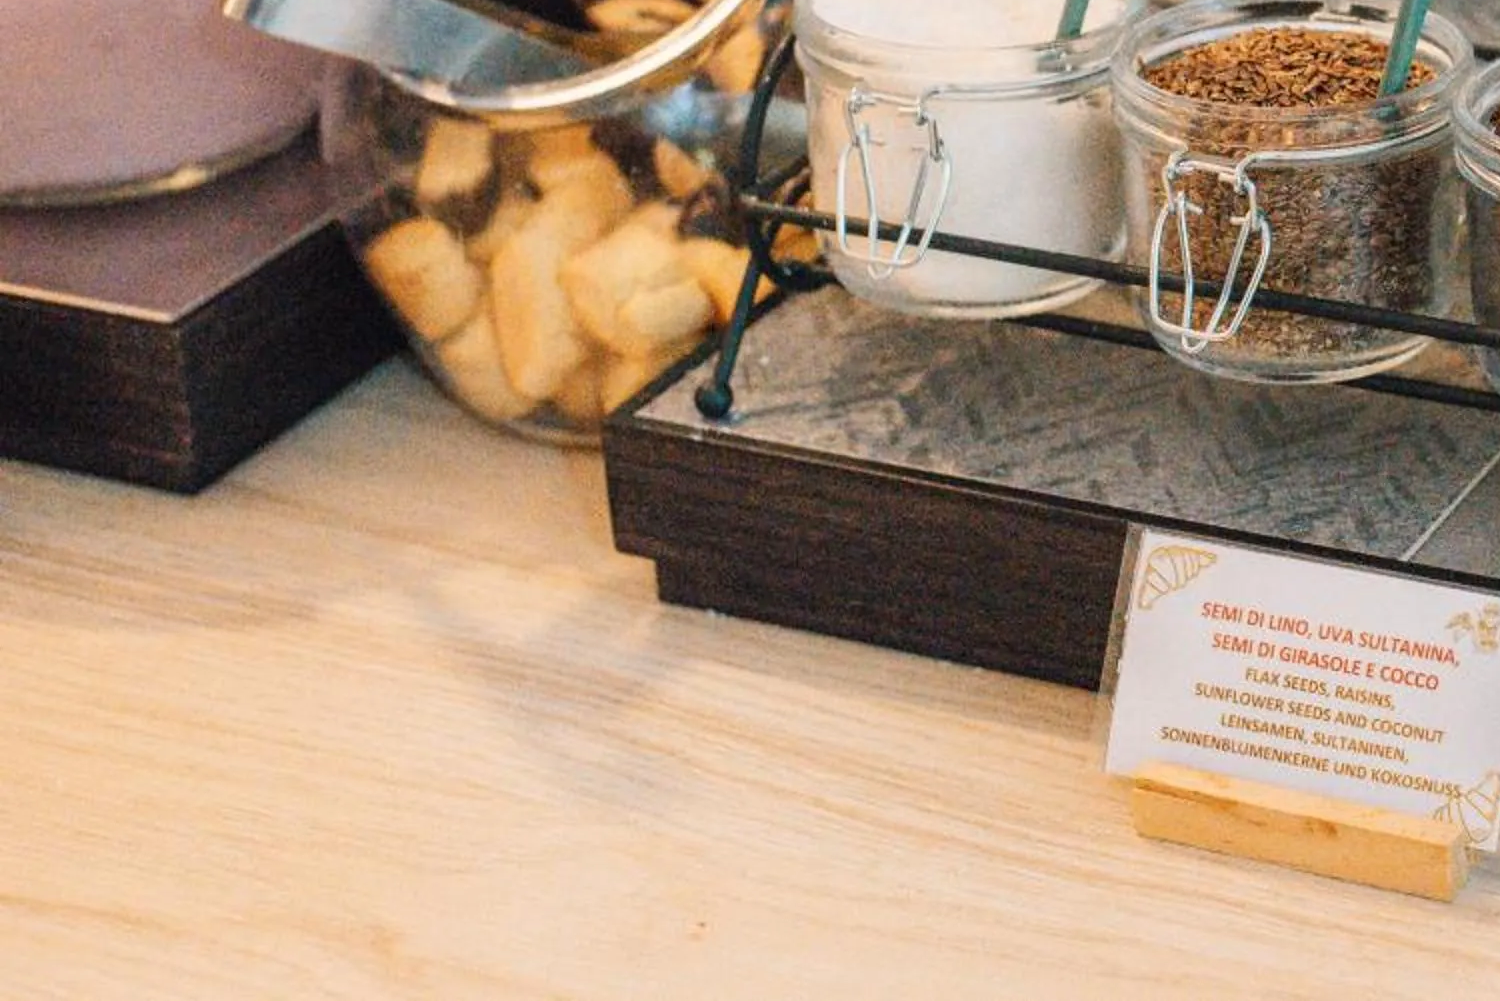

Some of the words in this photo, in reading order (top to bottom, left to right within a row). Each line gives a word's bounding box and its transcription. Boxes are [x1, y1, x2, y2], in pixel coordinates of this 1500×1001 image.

[1201, 601, 1243, 624] SEMI
[1246, 610, 1265, 628] DI
[1269, 615, 1312, 640] LINO,
[1319, 624, 1354, 645] UVA
[1359, 630, 1461, 668] SULTANINA,
[1212, 632, 1253, 654] SEMI
[1257, 642, 1276, 659] DI
[1279, 646, 1361, 676] GIRASOLE
[1365, 662, 1376, 678] E
[1380, 666, 1440, 690] COCCO
[1194, 682, 1284, 712] SUNFLOWER
[1287, 701, 1331, 722] SEEDS
[1334, 711, 1368, 729] AND
[1371, 718, 1446, 743] COCONUT
[1245, 668, 1281, 687] FLAX
[1282, 675, 1330, 699] SEEDS,
[1334, 686, 1395, 711] RAISINS,
[1160, 727, 1330, 773] SONNENBLUMENKERNE
[1334, 761, 1368, 780] UND
[1371, 769, 1464, 799] KOKOSNUSS
[1220, 714, 1309, 744] LEINSAMEN,
[1311, 731, 1409, 764] SULTANINEN,
